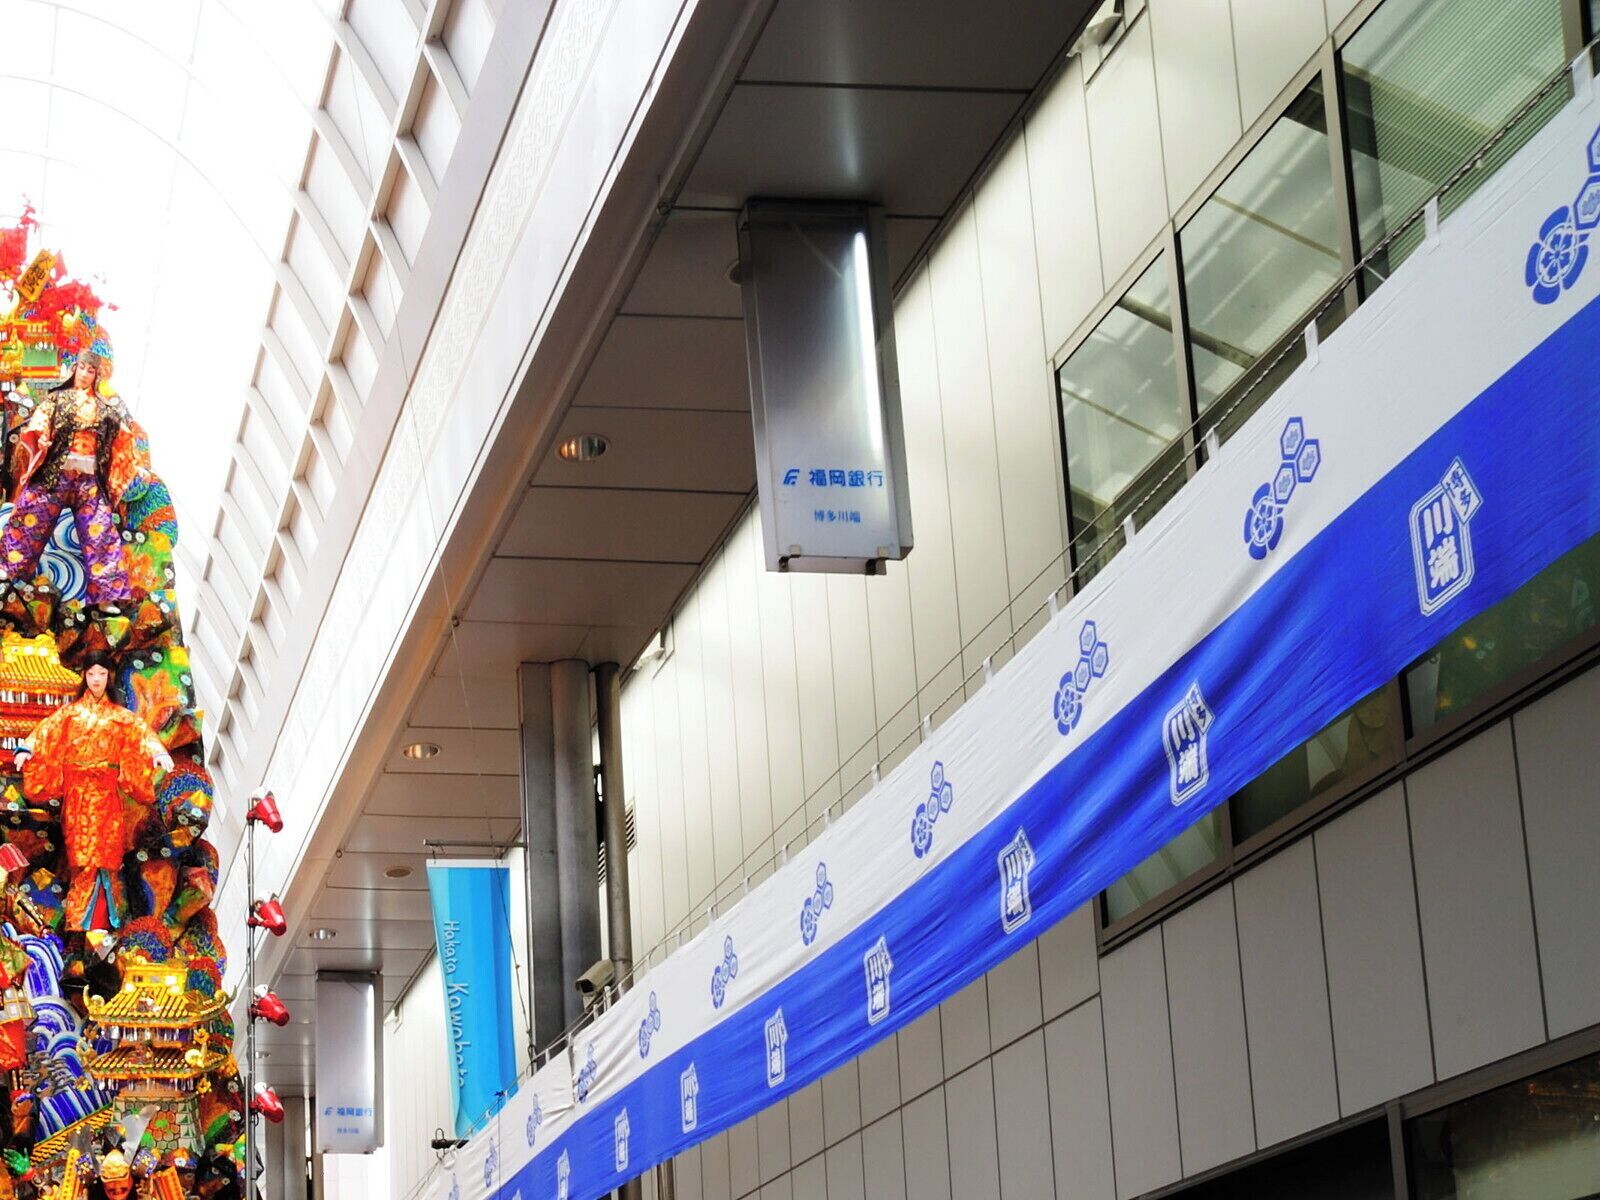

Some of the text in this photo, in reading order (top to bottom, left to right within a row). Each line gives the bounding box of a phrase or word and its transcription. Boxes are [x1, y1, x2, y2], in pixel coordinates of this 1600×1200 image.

[808, 469, 884, 487] 福岡銀行
[1445, 467, 1472, 517] 博多
[814, 508, 861, 523] 博多川端
[1423, 494, 1460, 589] 川端
[1170, 705, 1200, 785] 川端
[443, 921, 461, 974] Hakata
